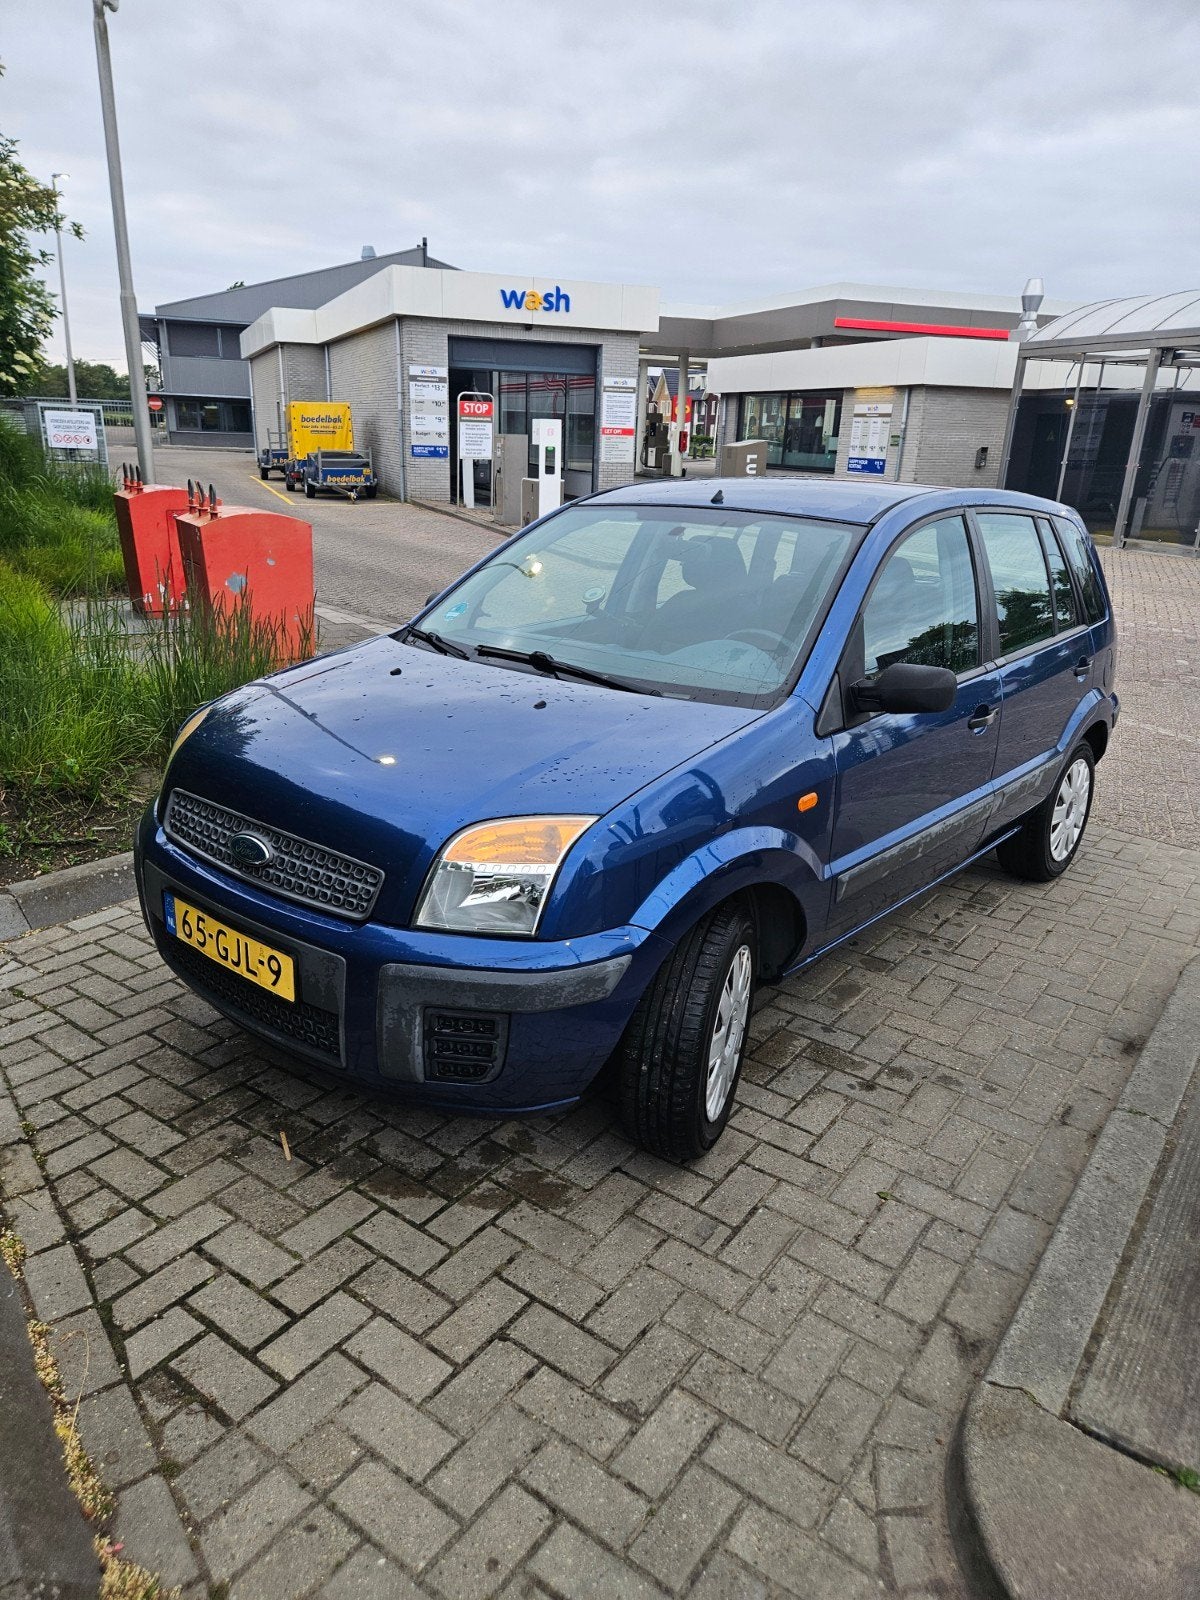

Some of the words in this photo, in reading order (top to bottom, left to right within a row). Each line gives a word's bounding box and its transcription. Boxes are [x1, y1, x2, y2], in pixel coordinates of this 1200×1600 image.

[500, 285, 570, 312] wash
[463, 402, 489, 414] STOP
[301, 414, 342, 424] boedelbak
[326, 475, 365, 483] boedelbak
[167, 915, 175, 928] NL
[182, 909, 282, 987] 65-GJL-9
